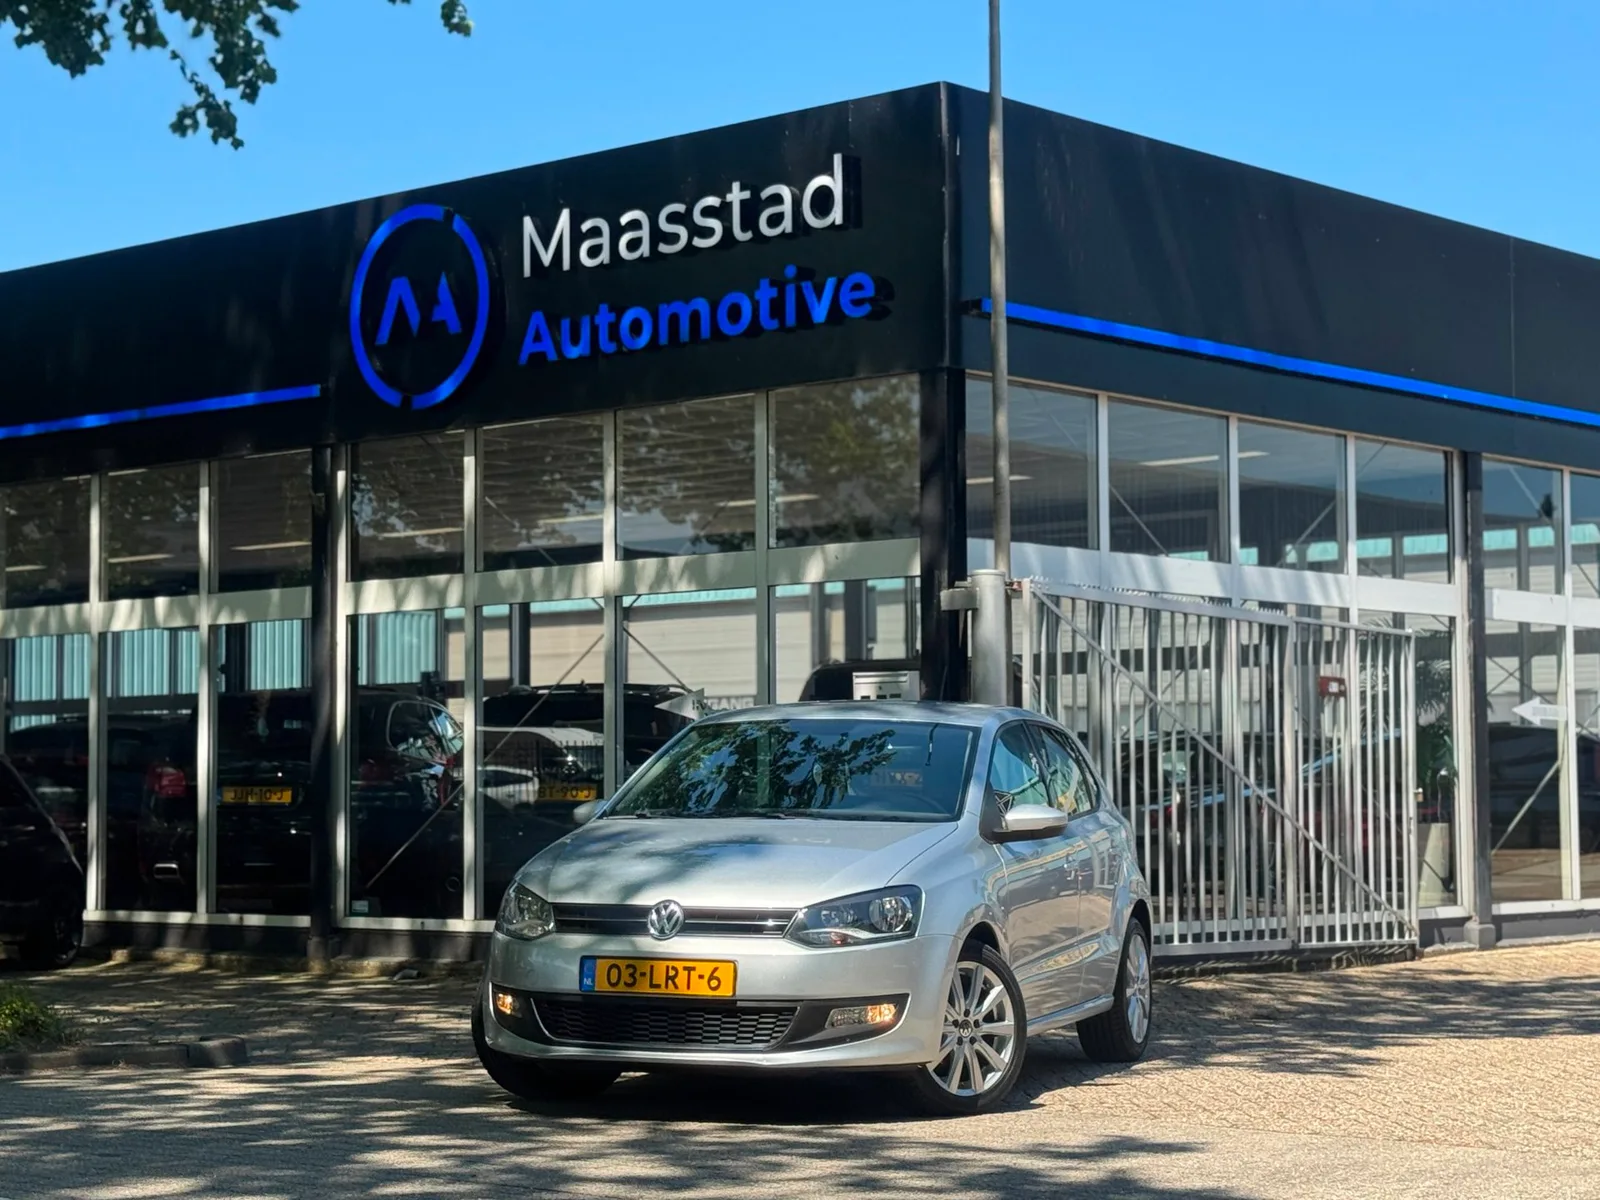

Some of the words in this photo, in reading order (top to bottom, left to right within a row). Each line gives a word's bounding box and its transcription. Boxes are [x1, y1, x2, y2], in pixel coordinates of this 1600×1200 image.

[522, 152, 844, 278] Maasstad
[518, 264, 876, 366] Automotive
[533, 785, 593, 799] BT-90-J
[583, 977, 593, 985] NL
[606, 963, 722, 991] 03-LRT-6
